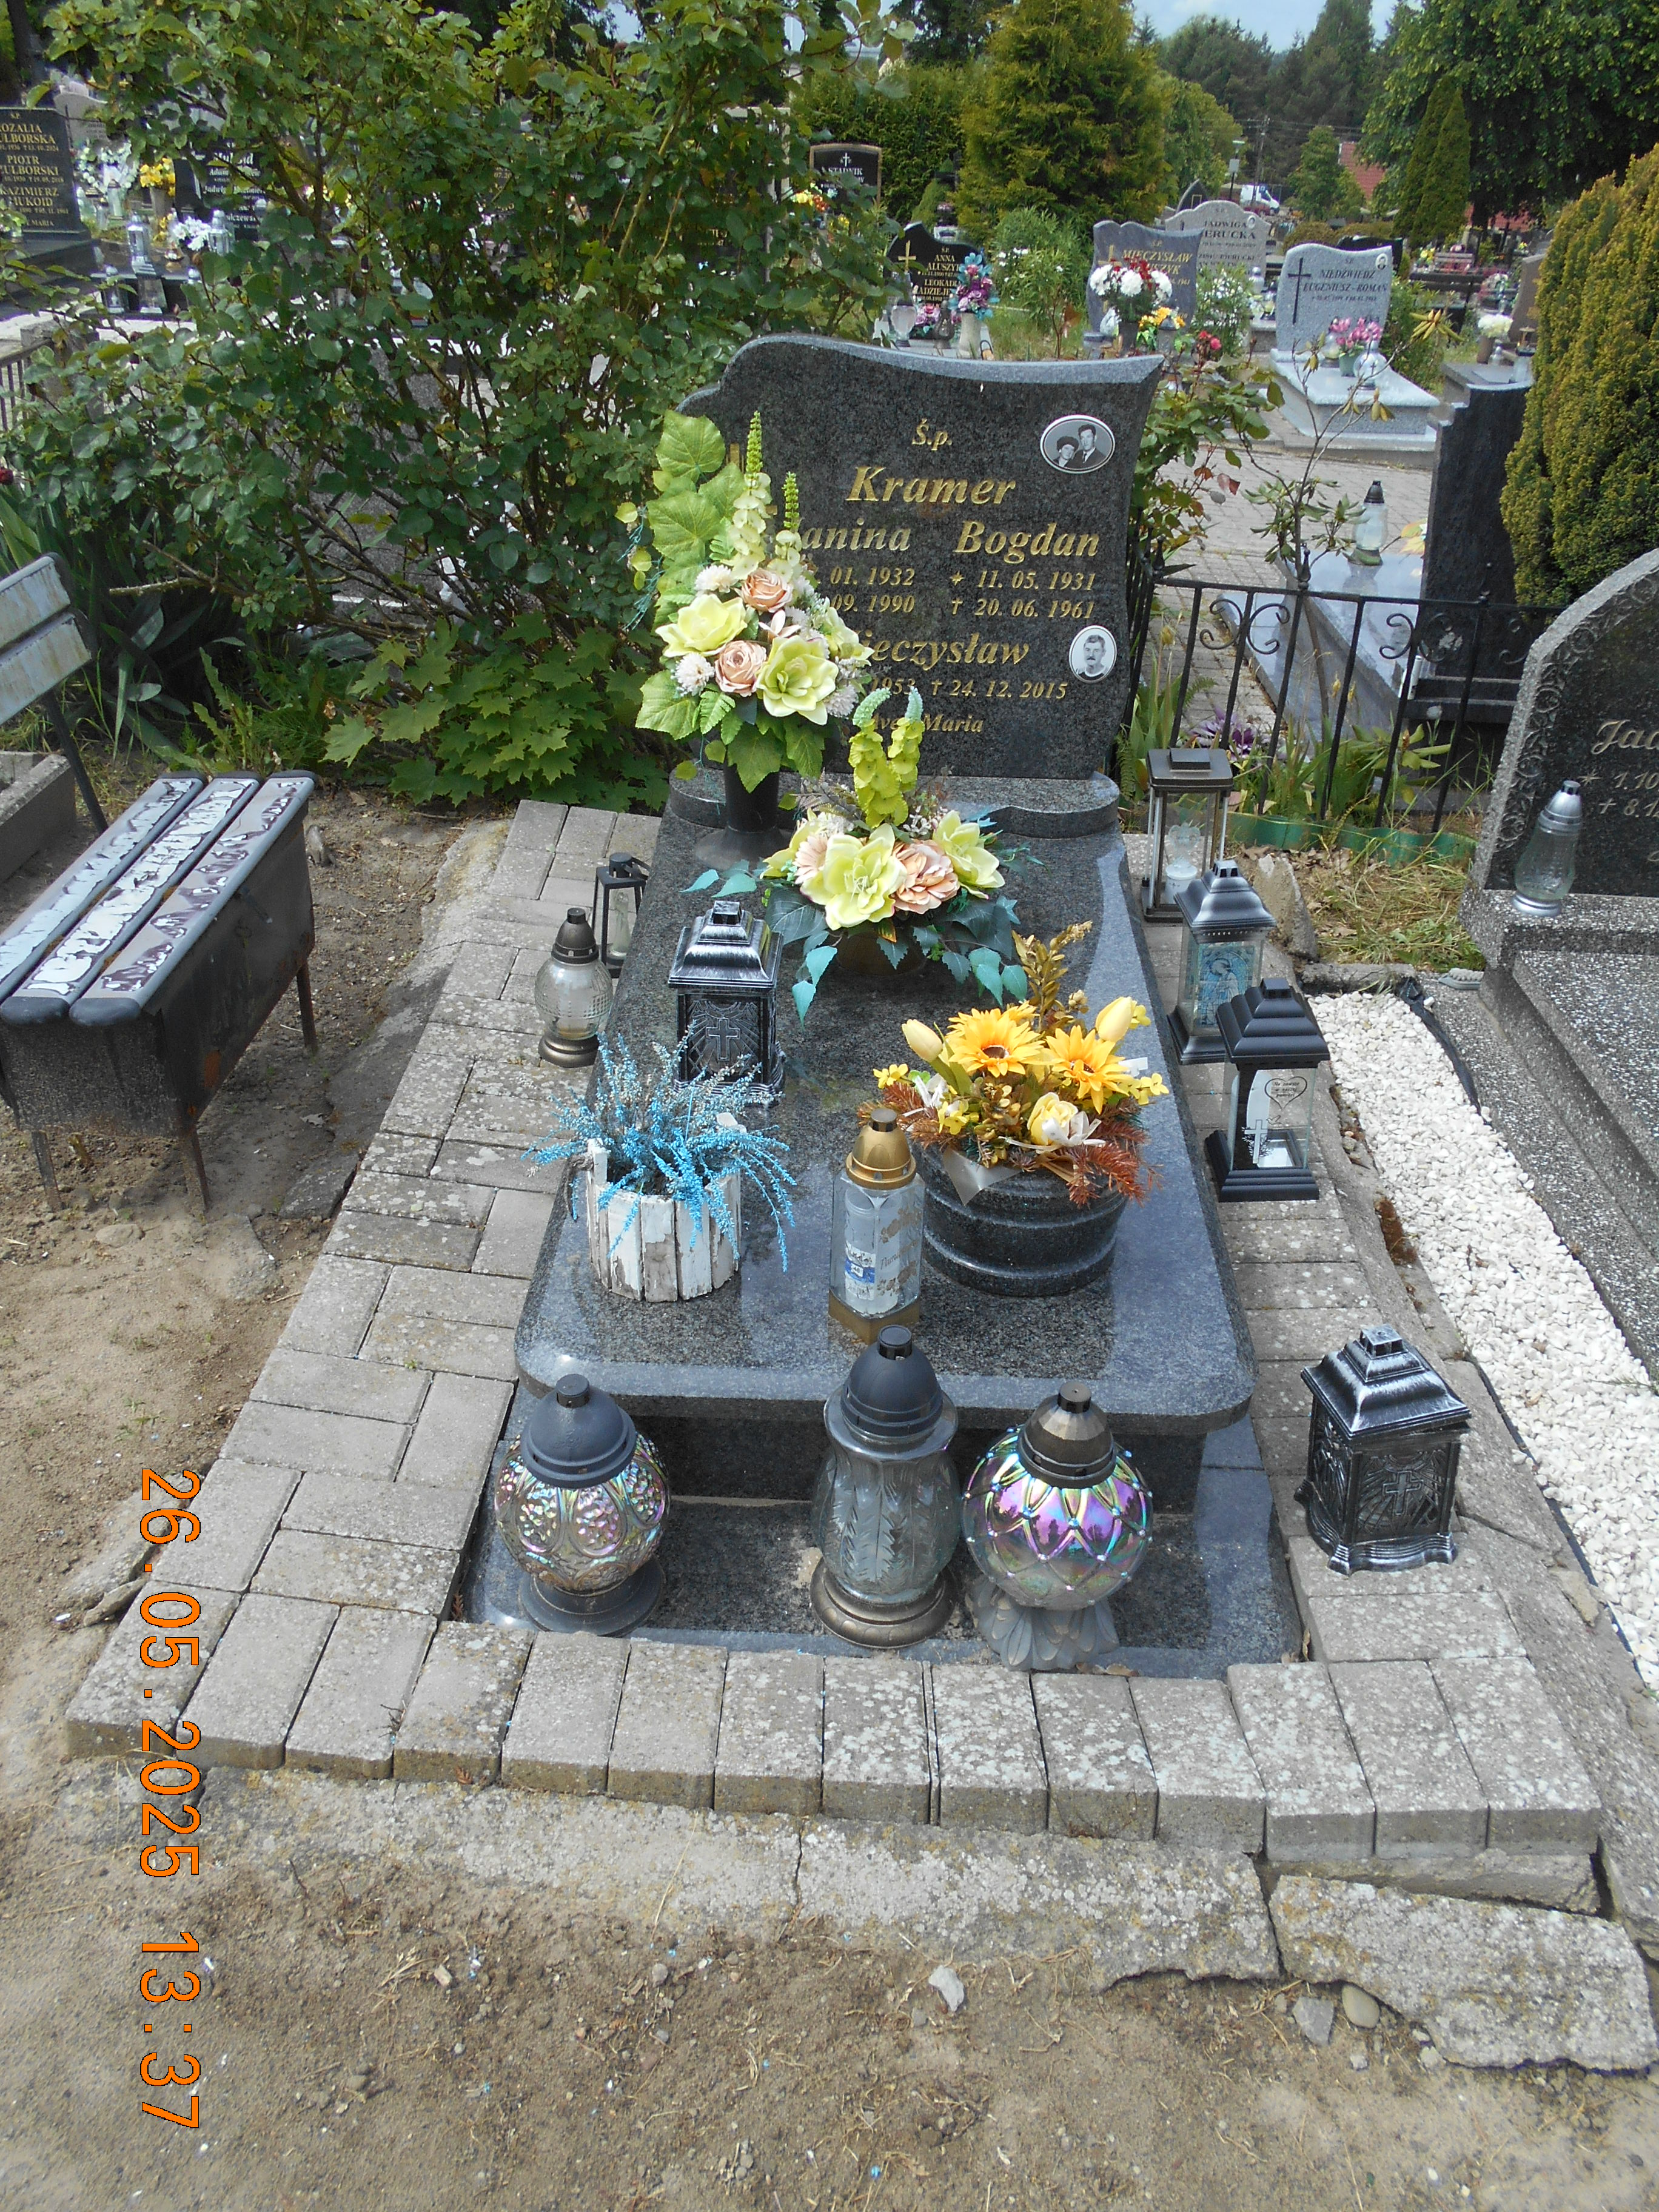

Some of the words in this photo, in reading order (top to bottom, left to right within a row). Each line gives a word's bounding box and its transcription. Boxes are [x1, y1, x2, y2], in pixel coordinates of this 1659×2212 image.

[0, 122, 42, 133] OZALIA
[7, 155, 39, 164] PIOTR
[912, 418, 953, 451] Ś.p.
[845, 465, 1016, 505] Kramer
[799, 517, 911, 551] anina
[953, 520, 1100, 565] Bogdan
[830, 566, 858, 585] 01.
[868, 566, 916, 586] 1932
[977, 569, 1003, 588] 11.
[1011, 570, 1039, 589] 05.
[1048, 571, 1096, 591] 1931
[831, 594, 858, 612] 09.
[867, 594, 916, 613] 1990
[974, 598, 1002, 616] 20.
[1011, 598, 1039, 617] 06.
[1048, 600, 1095, 618] 1961
[859, 629, 1030, 670] ieczysław
[950, 680, 976, 697] 24.
[986, 680, 1012, 697] 12.
[1019, 682, 1068, 699] 2015
[923, 714, 984, 732] Maria
